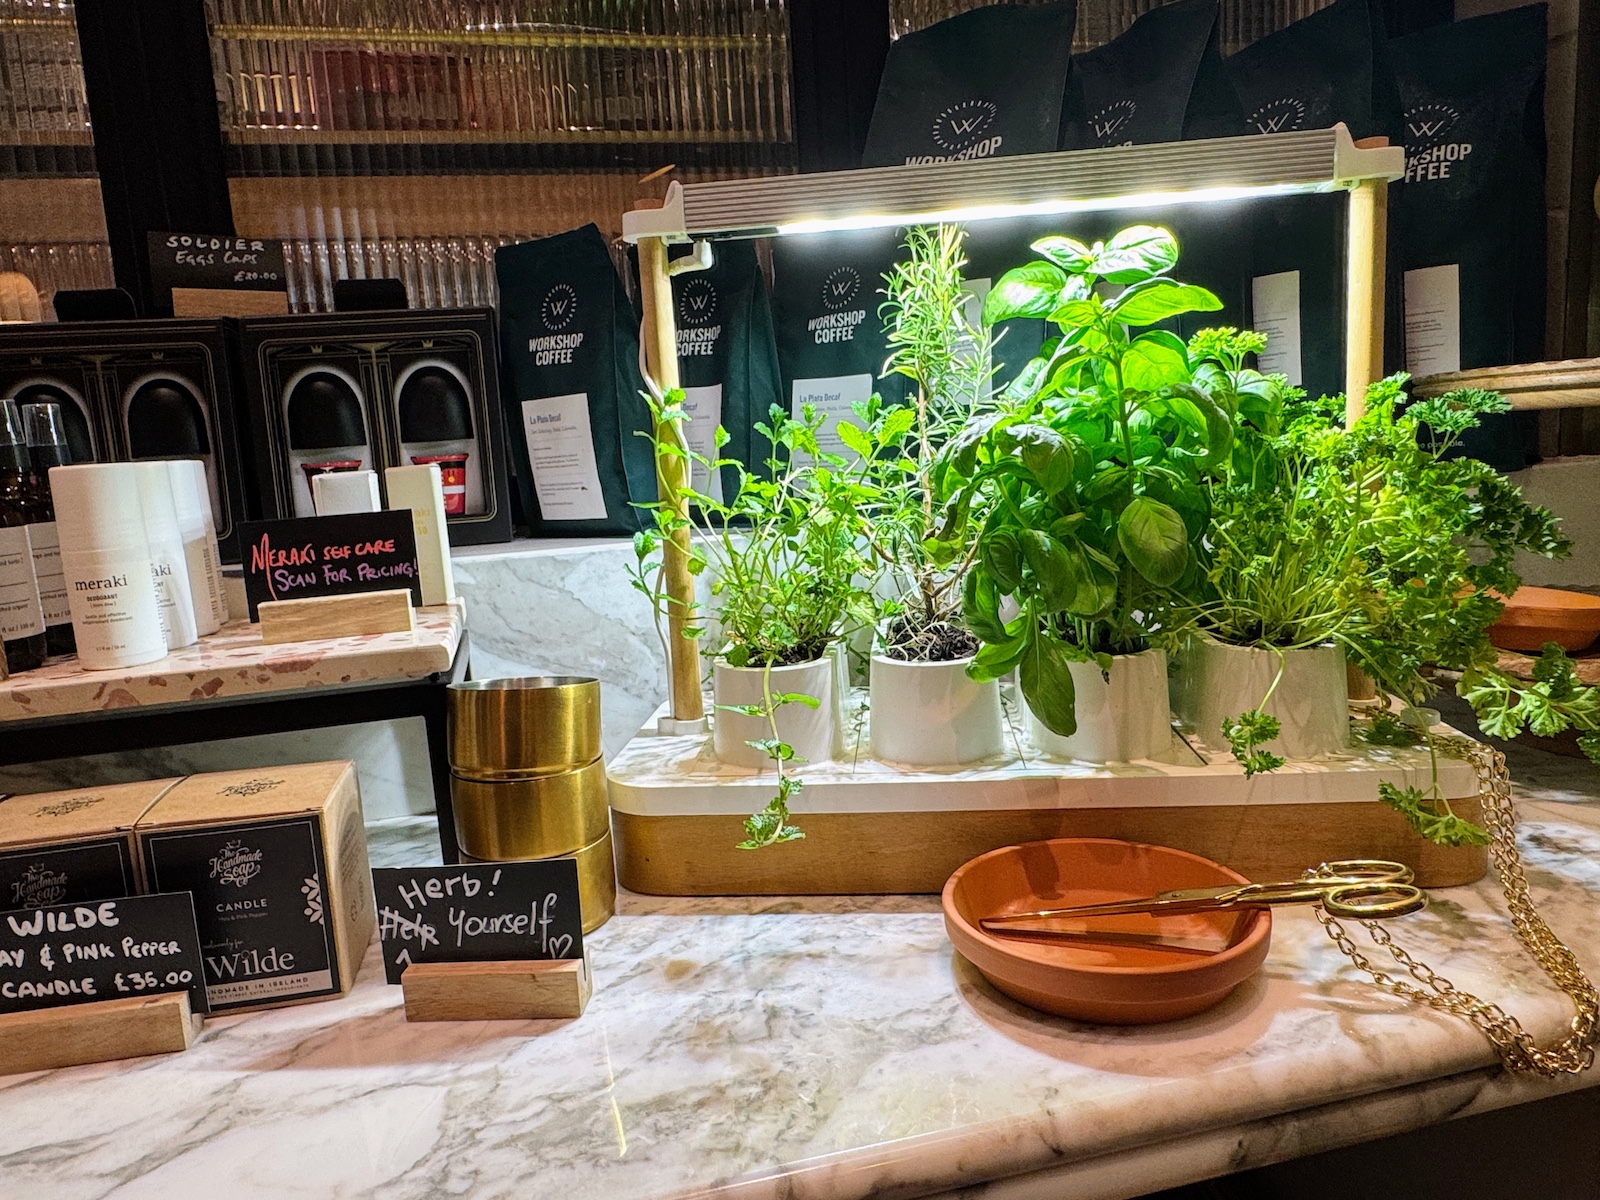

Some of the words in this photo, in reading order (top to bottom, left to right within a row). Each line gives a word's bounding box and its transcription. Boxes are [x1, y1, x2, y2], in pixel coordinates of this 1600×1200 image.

[1405, 143, 1472, 168] KSHOP
[1404, 161, 1452, 184] FFEE
[166, 235, 265, 252] SOLDIER
[807, 309, 867, 332] WORKSHOP
[528, 332, 584, 353] WORKSHOP
[676, 324, 722, 343] ORKSHOP
[814, 325, 855, 344] COFFEE
[535, 348, 574, 367] COFFEE
[799, 394, 808, 403] La
[824, 392, 841, 402] Decaf
[154, 563, 172, 577] aki
[252, 533, 316, 601] MERAKI
[354, 539, 396, 557] CARE
[274, 568, 317, 592] SCAN
[322, 564, 353, 586] FOR
[357, 557, 420, 582] PRICING!
[74, 574, 129, 592] meraki
[208, 848, 263, 879] Handmade
[220, 862, 261, 885] Soap
[216, 898, 268, 912] CANDLE
[7, 902, 120, 937] WILDE
[0, 948, 25, 968] AY
[62, 943, 115, 964] PINK
[121, 936, 182, 959] PEPPER
[204, 946, 296, 979] Wilde
[1, 977, 97, 999] CANDLE
[207, 985, 250, 996] NDMADE
[269, 977, 309, 988] IRELAND
